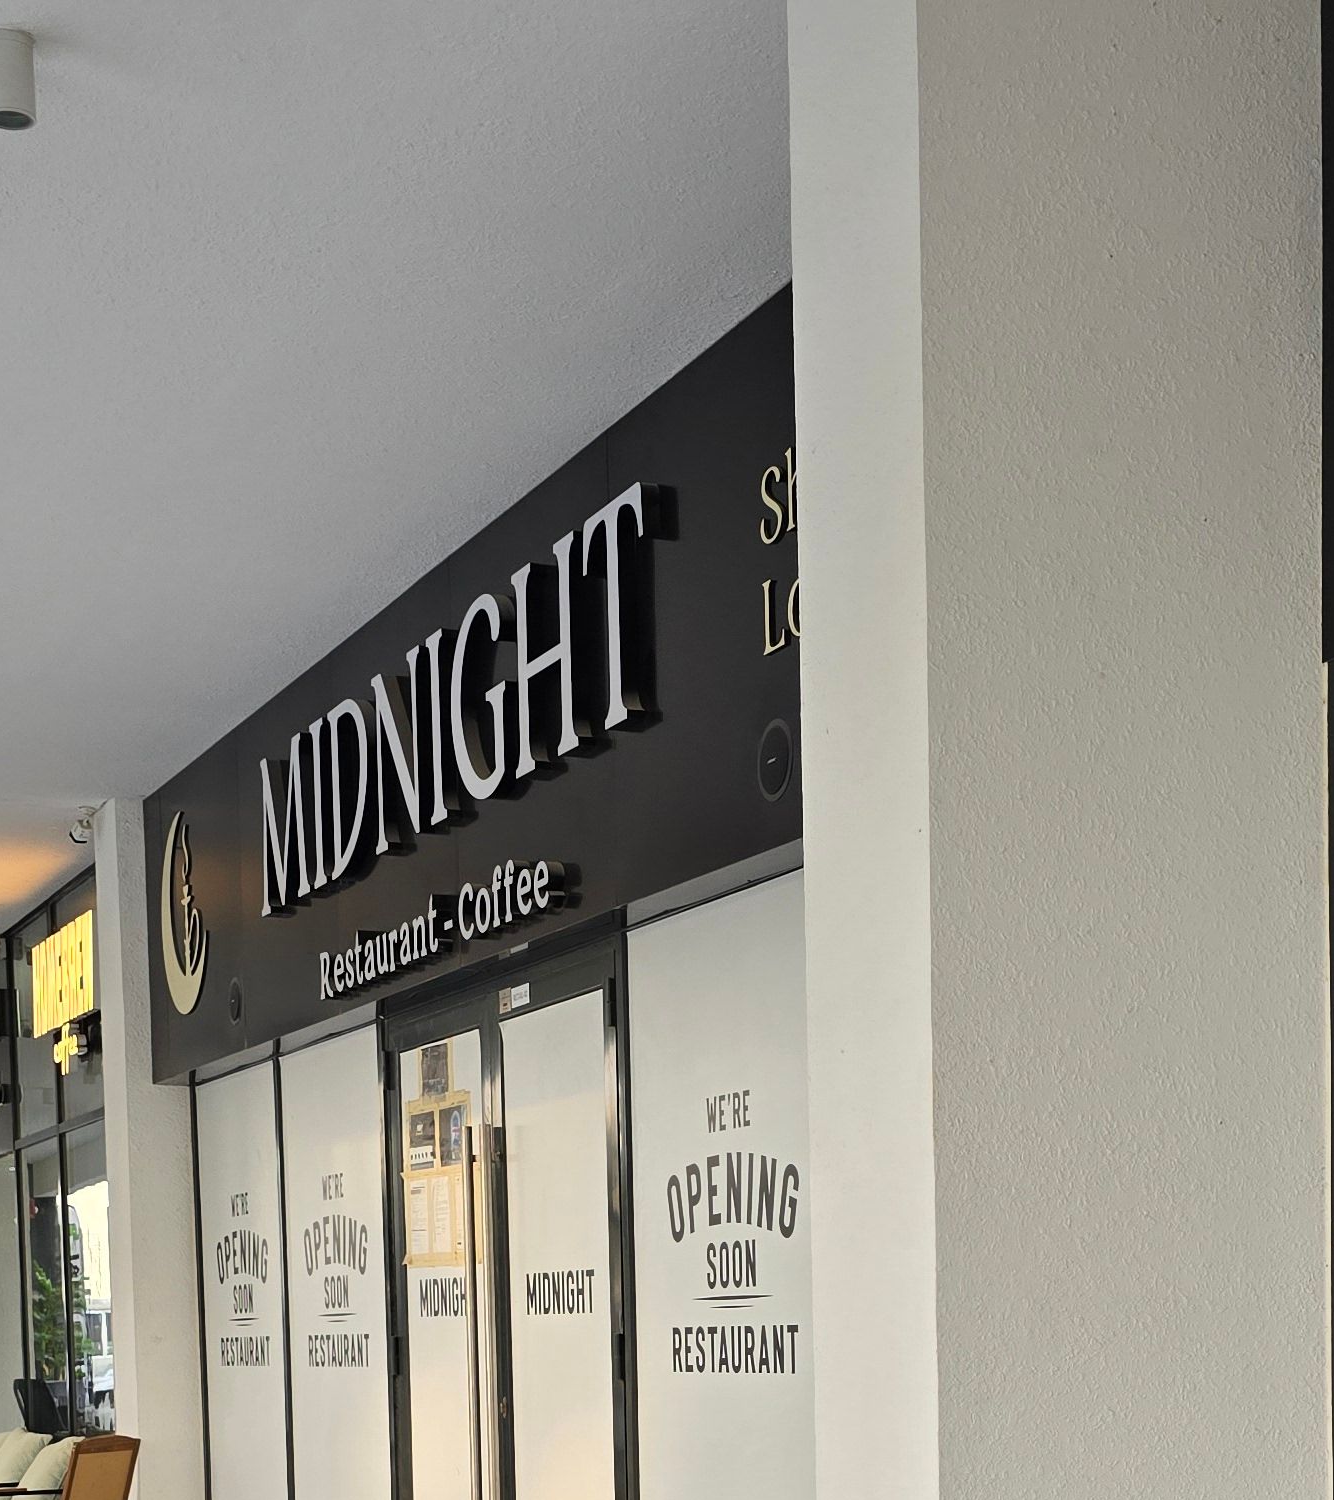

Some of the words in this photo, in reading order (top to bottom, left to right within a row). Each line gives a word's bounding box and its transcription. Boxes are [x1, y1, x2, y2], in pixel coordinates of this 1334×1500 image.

[260, 481, 644, 917] MIDNIGHT
[319, 893, 439, 1000] Restaurant
[458, 859, 549, 940] Coffee
[706, 1089, 751, 1133] WE'RE
[230, 1192, 249, 1217] WE'RE
[322, 1173, 344, 1201] WE'RE
[667, 1151, 799, 1243] OPENING
[216, 1229, 268, 1285] OPENING
[303, 1214, 368, 1276] OPENING
[706, 1239, 757, 1289] SOON
[233, 1283, 254, 1314] SOON
[324, 1275, 349, 1309] SOON
[420, 1276, 467, 1318] MIDNIGH
[526, 1269, 595, 1316] MIDNIGHT
[220, 1335, 271, 1367] RESTAURANT
[308, 1333, 369, 1368] RESTAURANT
[672, 1325, 799, 1374] RESTAURANT
